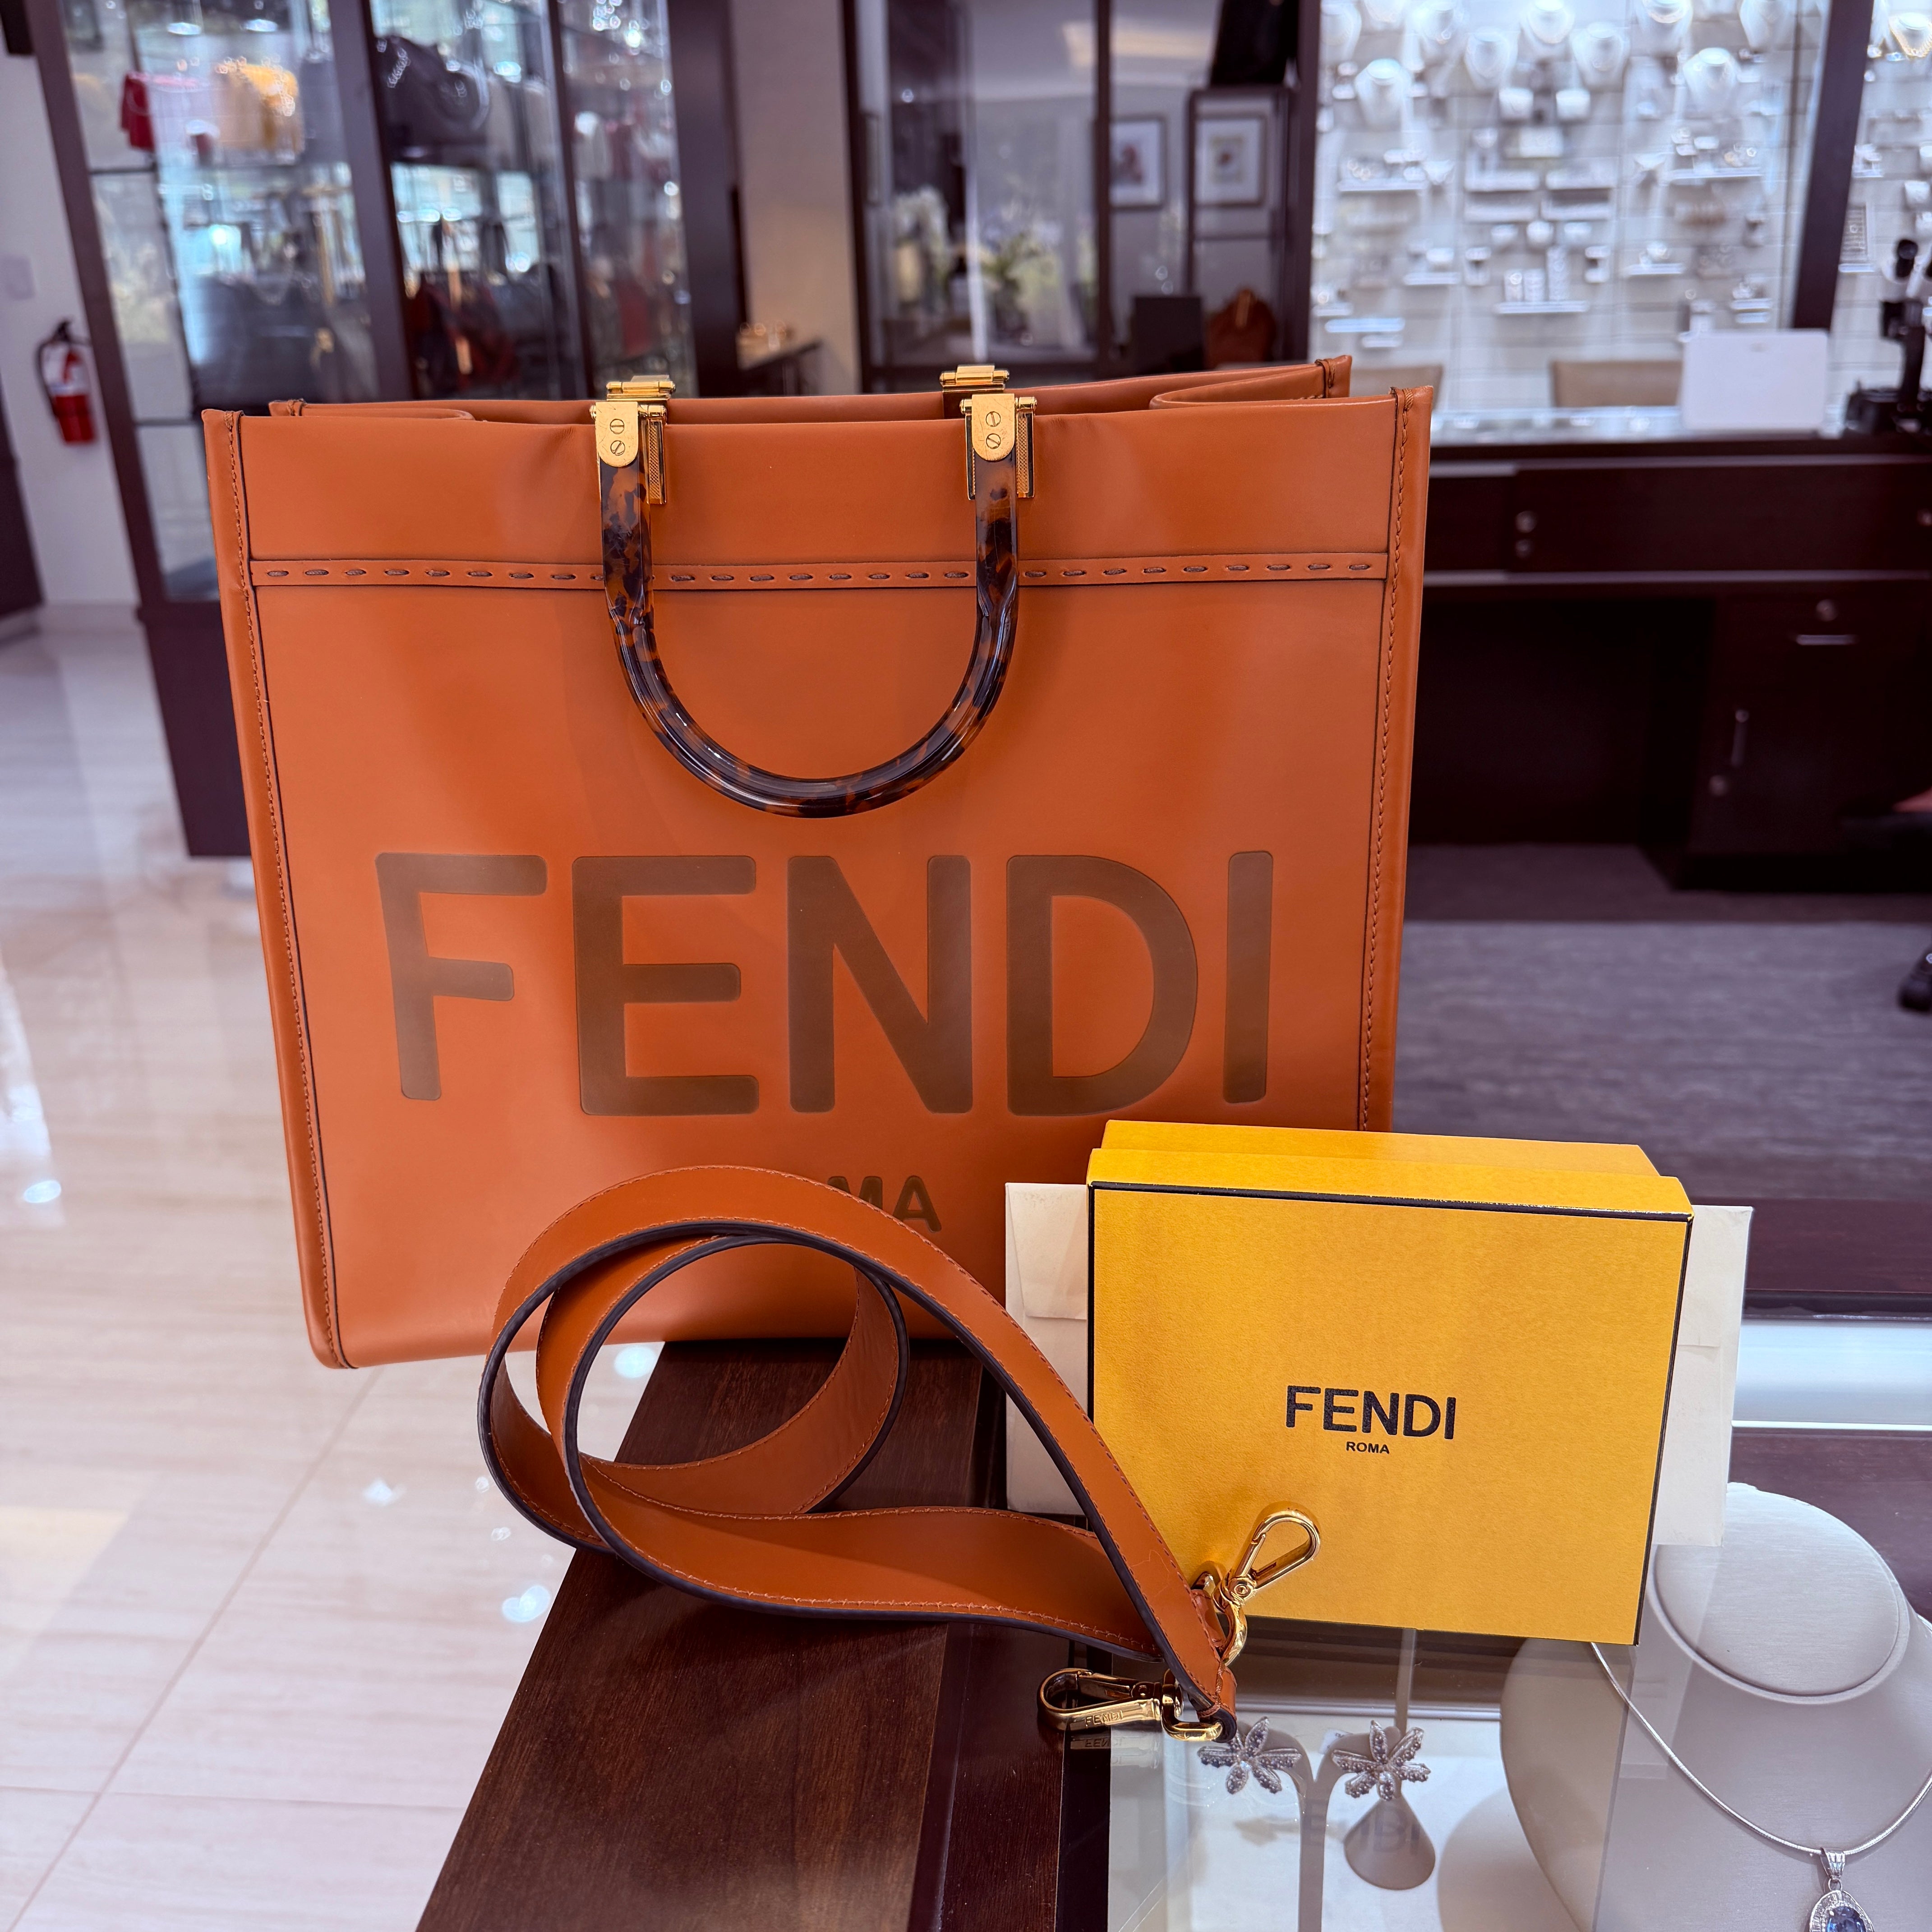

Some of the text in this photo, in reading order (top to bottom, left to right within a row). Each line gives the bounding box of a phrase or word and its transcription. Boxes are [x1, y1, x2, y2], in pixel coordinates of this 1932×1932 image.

[375, 850, 1274, 1116] FENDI
[1286, 1385, 1457, 1440] FENDI
[1346, 1441, 1390, 1454] ROMA
[1084, 1710, 1123, 1729] FENDI
